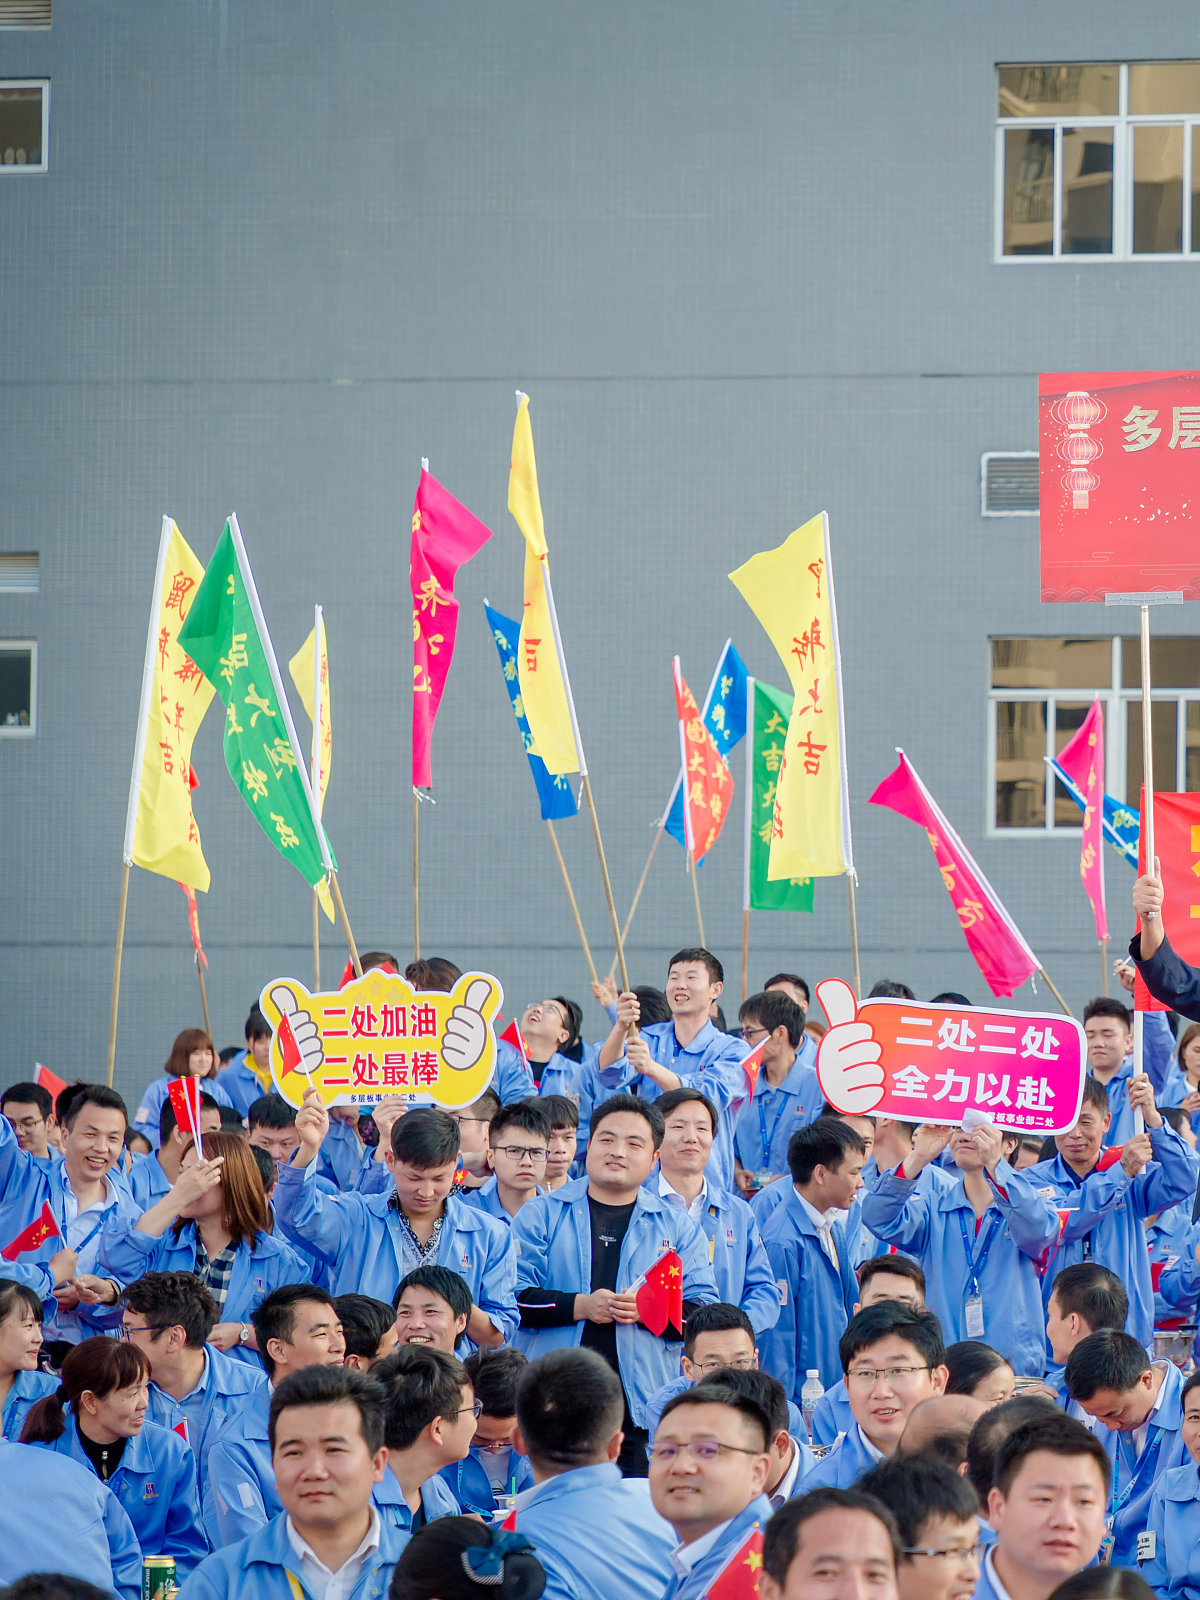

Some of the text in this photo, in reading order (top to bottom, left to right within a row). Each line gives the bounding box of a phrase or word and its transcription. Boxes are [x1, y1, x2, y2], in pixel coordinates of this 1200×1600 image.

[322, 1002, 438, 1039] 二处加油
[896, 1016, 1061, 1061] 二处二处
[323, 1051, 440, 1087] 二处最棒
[891, 1064, 1056, 1112] 全力以赴
